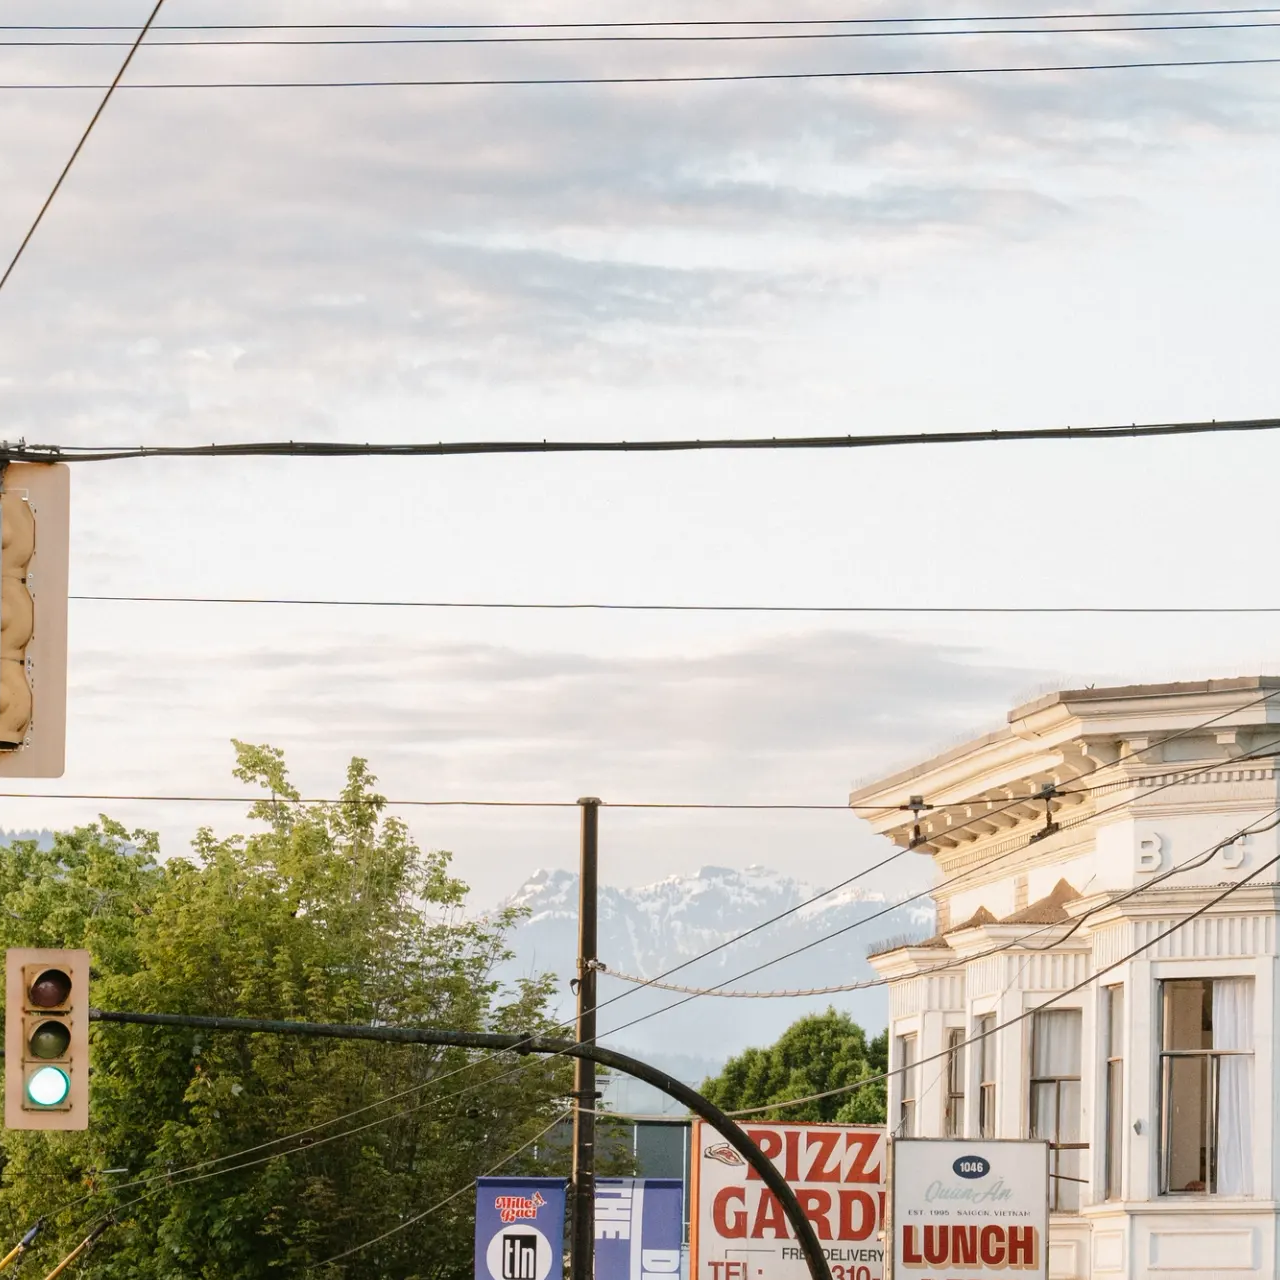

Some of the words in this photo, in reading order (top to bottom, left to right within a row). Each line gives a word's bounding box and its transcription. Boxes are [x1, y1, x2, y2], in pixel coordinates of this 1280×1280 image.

[746, 1130, 886, 1184] PIZZ
[960, 1162, 984, 1173] 1046
[495, 1196, 532, 1209] Mille
[500, 1207, 537, 1223] Baci
[713, 1186, 885, 1242] GARD
[903, 1225, 1037, 1268] LUNCH
[782, 1248, 807, 1259] FRE
[823, 1250, 884, 1262] DELIVERY
